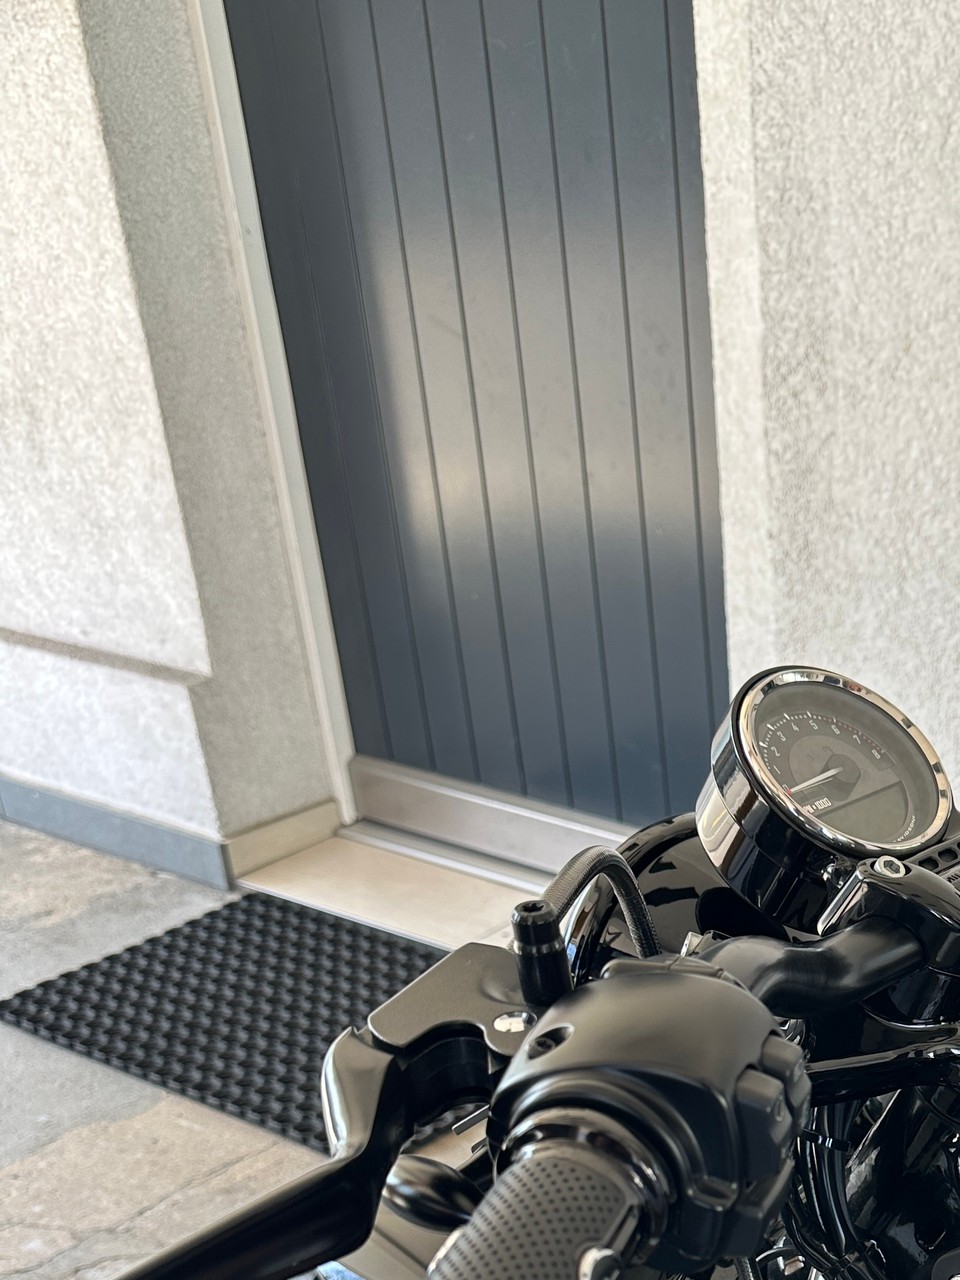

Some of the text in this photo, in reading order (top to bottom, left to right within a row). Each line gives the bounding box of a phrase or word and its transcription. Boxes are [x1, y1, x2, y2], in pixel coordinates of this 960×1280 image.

[777, 731, 786, 742] 3
[771, 746, 780, 757] 2
[871, 749, 881, 760] 8
